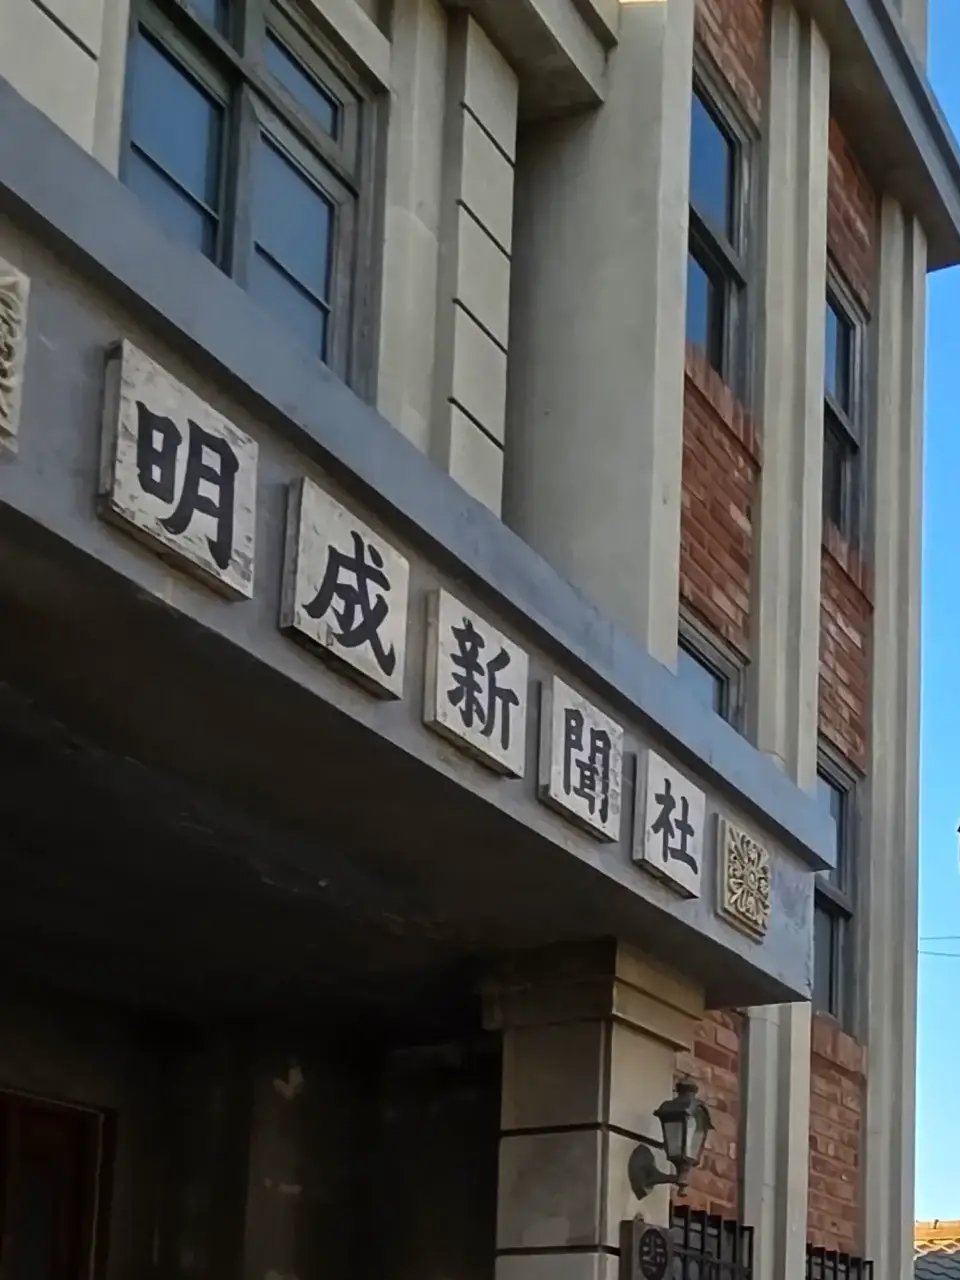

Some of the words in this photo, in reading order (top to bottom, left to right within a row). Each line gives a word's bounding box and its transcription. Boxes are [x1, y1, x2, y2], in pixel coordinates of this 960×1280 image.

[136, 402, 698, 875] 明成新聞社
